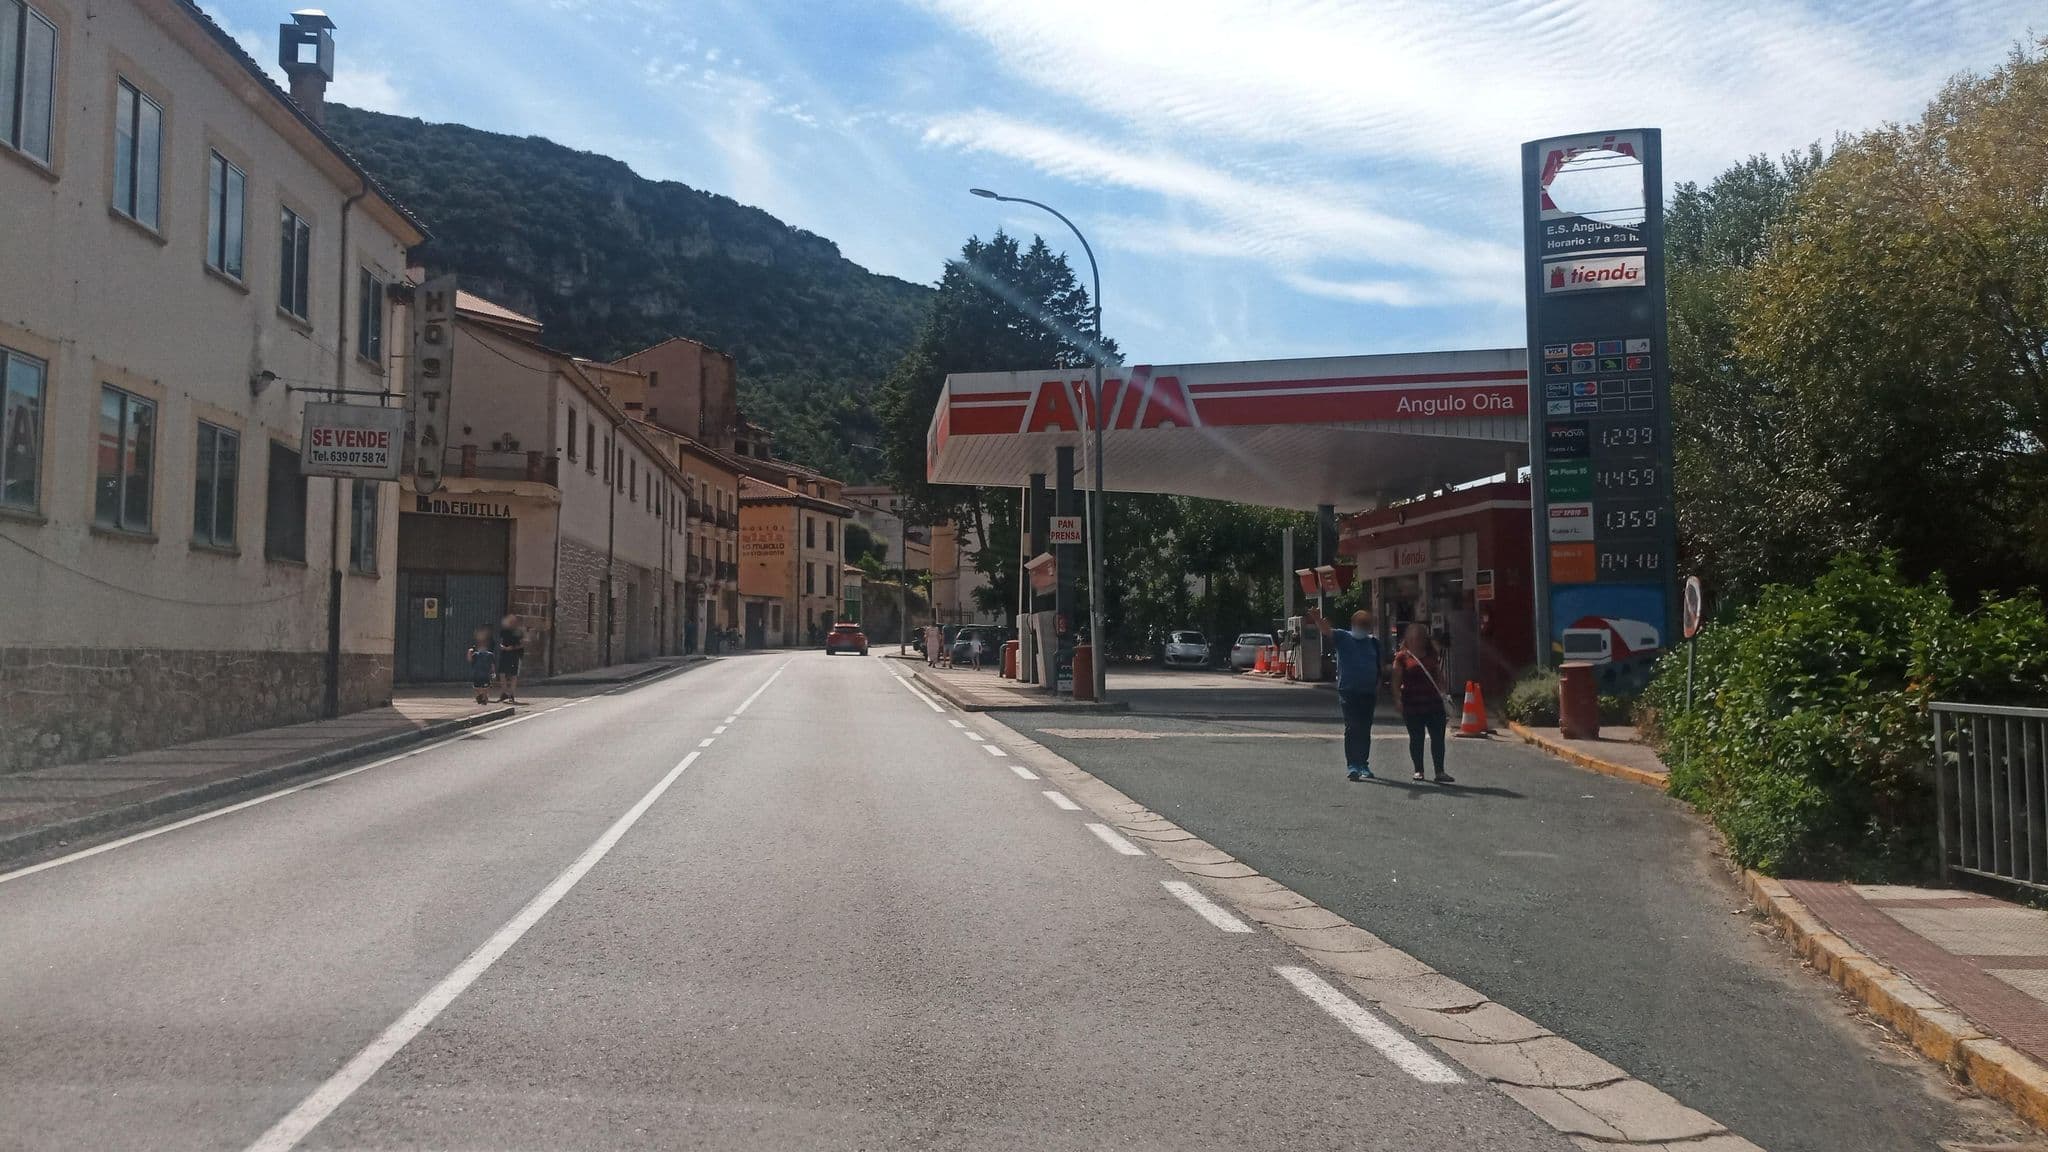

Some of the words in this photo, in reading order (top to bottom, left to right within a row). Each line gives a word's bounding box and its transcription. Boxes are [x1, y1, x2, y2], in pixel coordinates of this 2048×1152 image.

[1547, 224, 1569, 235] E.S.
[1547, 237, 1585, 249] Horario
[1594, 236, 1601, 244] 7
[1570, 262, 1639, 284] tienda
[417, 290, 445, 478] HOSTAL
[1026, 364, 1193, 433] AVIA
[1396, 394, 1466, 416] Angulo
[1473, 392, 1514, 410] Oña
[312, 429, 332, 447] SE
[335, 429, 388, 449] VENDE
[313, 450, 329, 462] Tel.
[330, 451, 348, 462] 639
[349, 452, 361, 463] 07
[362, 452, 374, 463] 58
[375, 452, 386, 464] 74
[424, 498, 511, 518] ODEGUILLA
[1057, 519, 1074, 529] PAN
[1050, 531, 1080, 540] PRENSA
